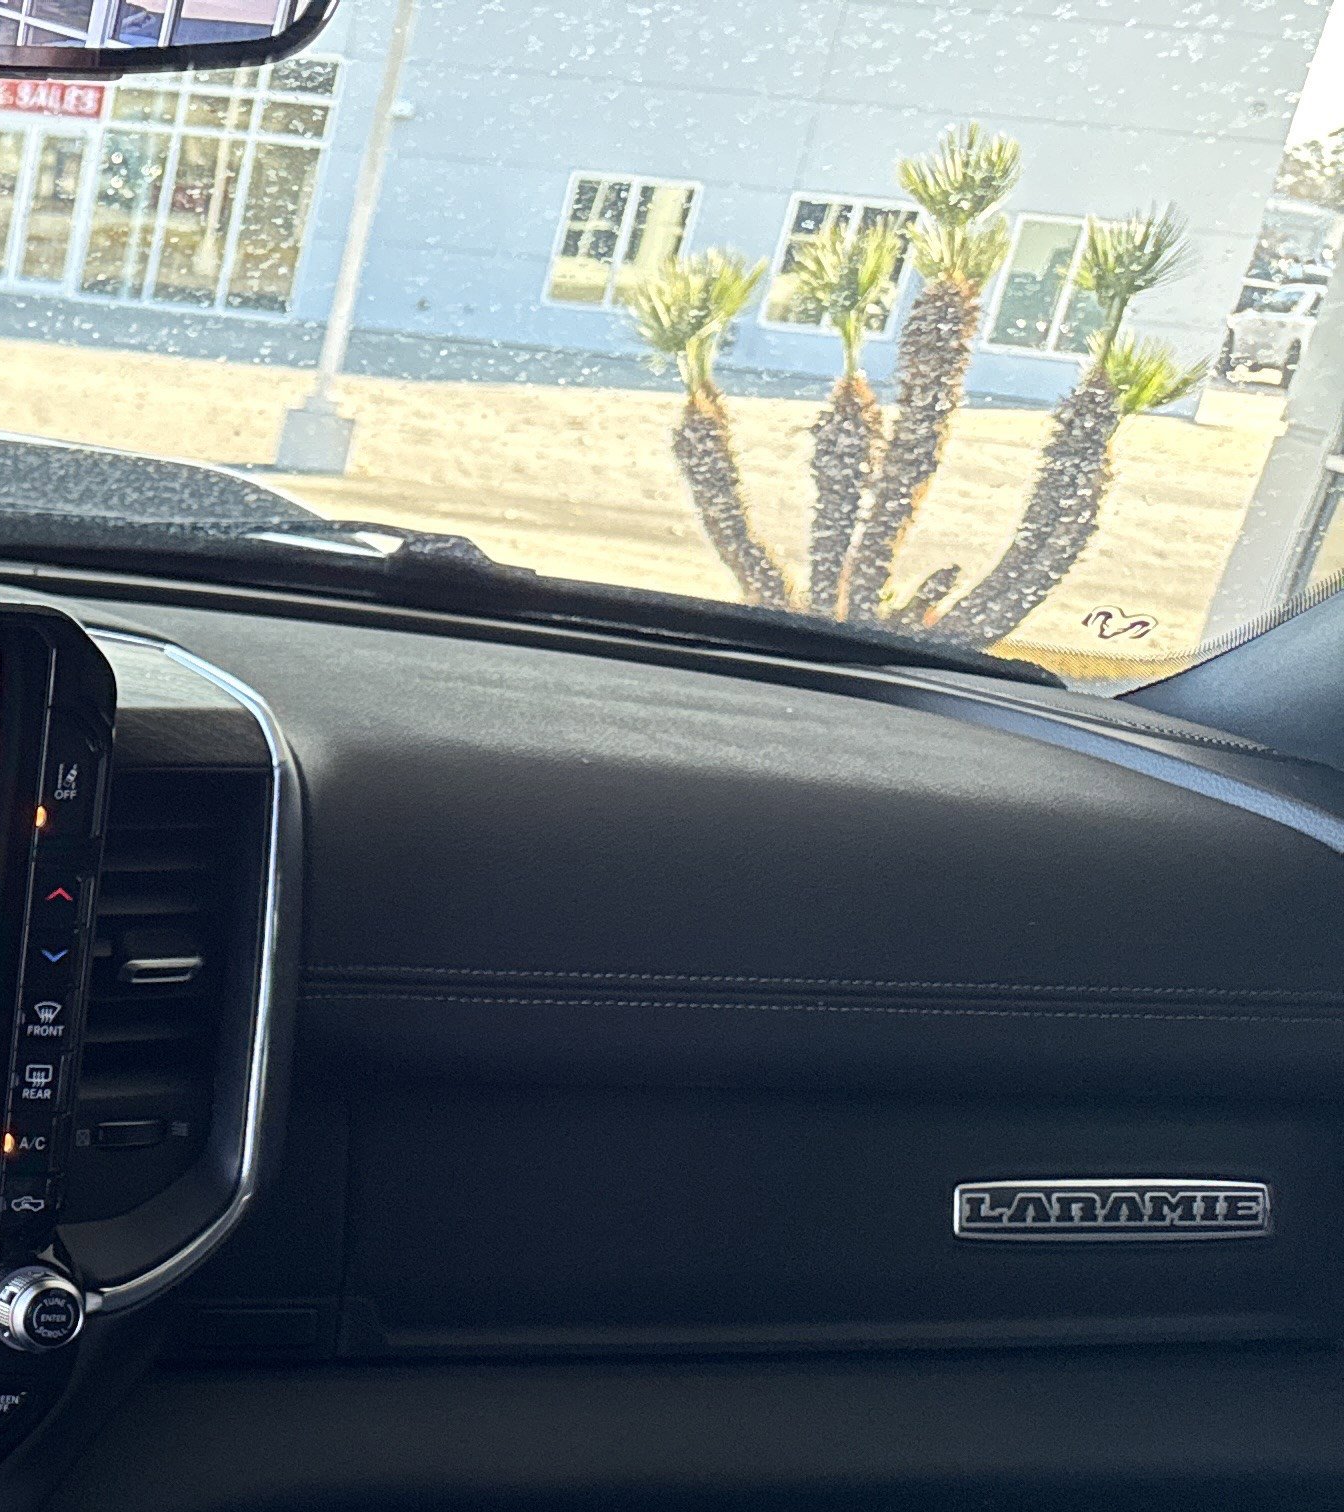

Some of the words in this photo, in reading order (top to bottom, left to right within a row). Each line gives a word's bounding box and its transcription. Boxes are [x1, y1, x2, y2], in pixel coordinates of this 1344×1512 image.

[54, 789, 78, 801] OFF
[26, 1024, 65, 1037] FRONT
[22, 1088, 52, 1100] REAR
[19, 1136, 46, 1150] A/C
[962, 1192, 1264, 1227] LARAMIE
